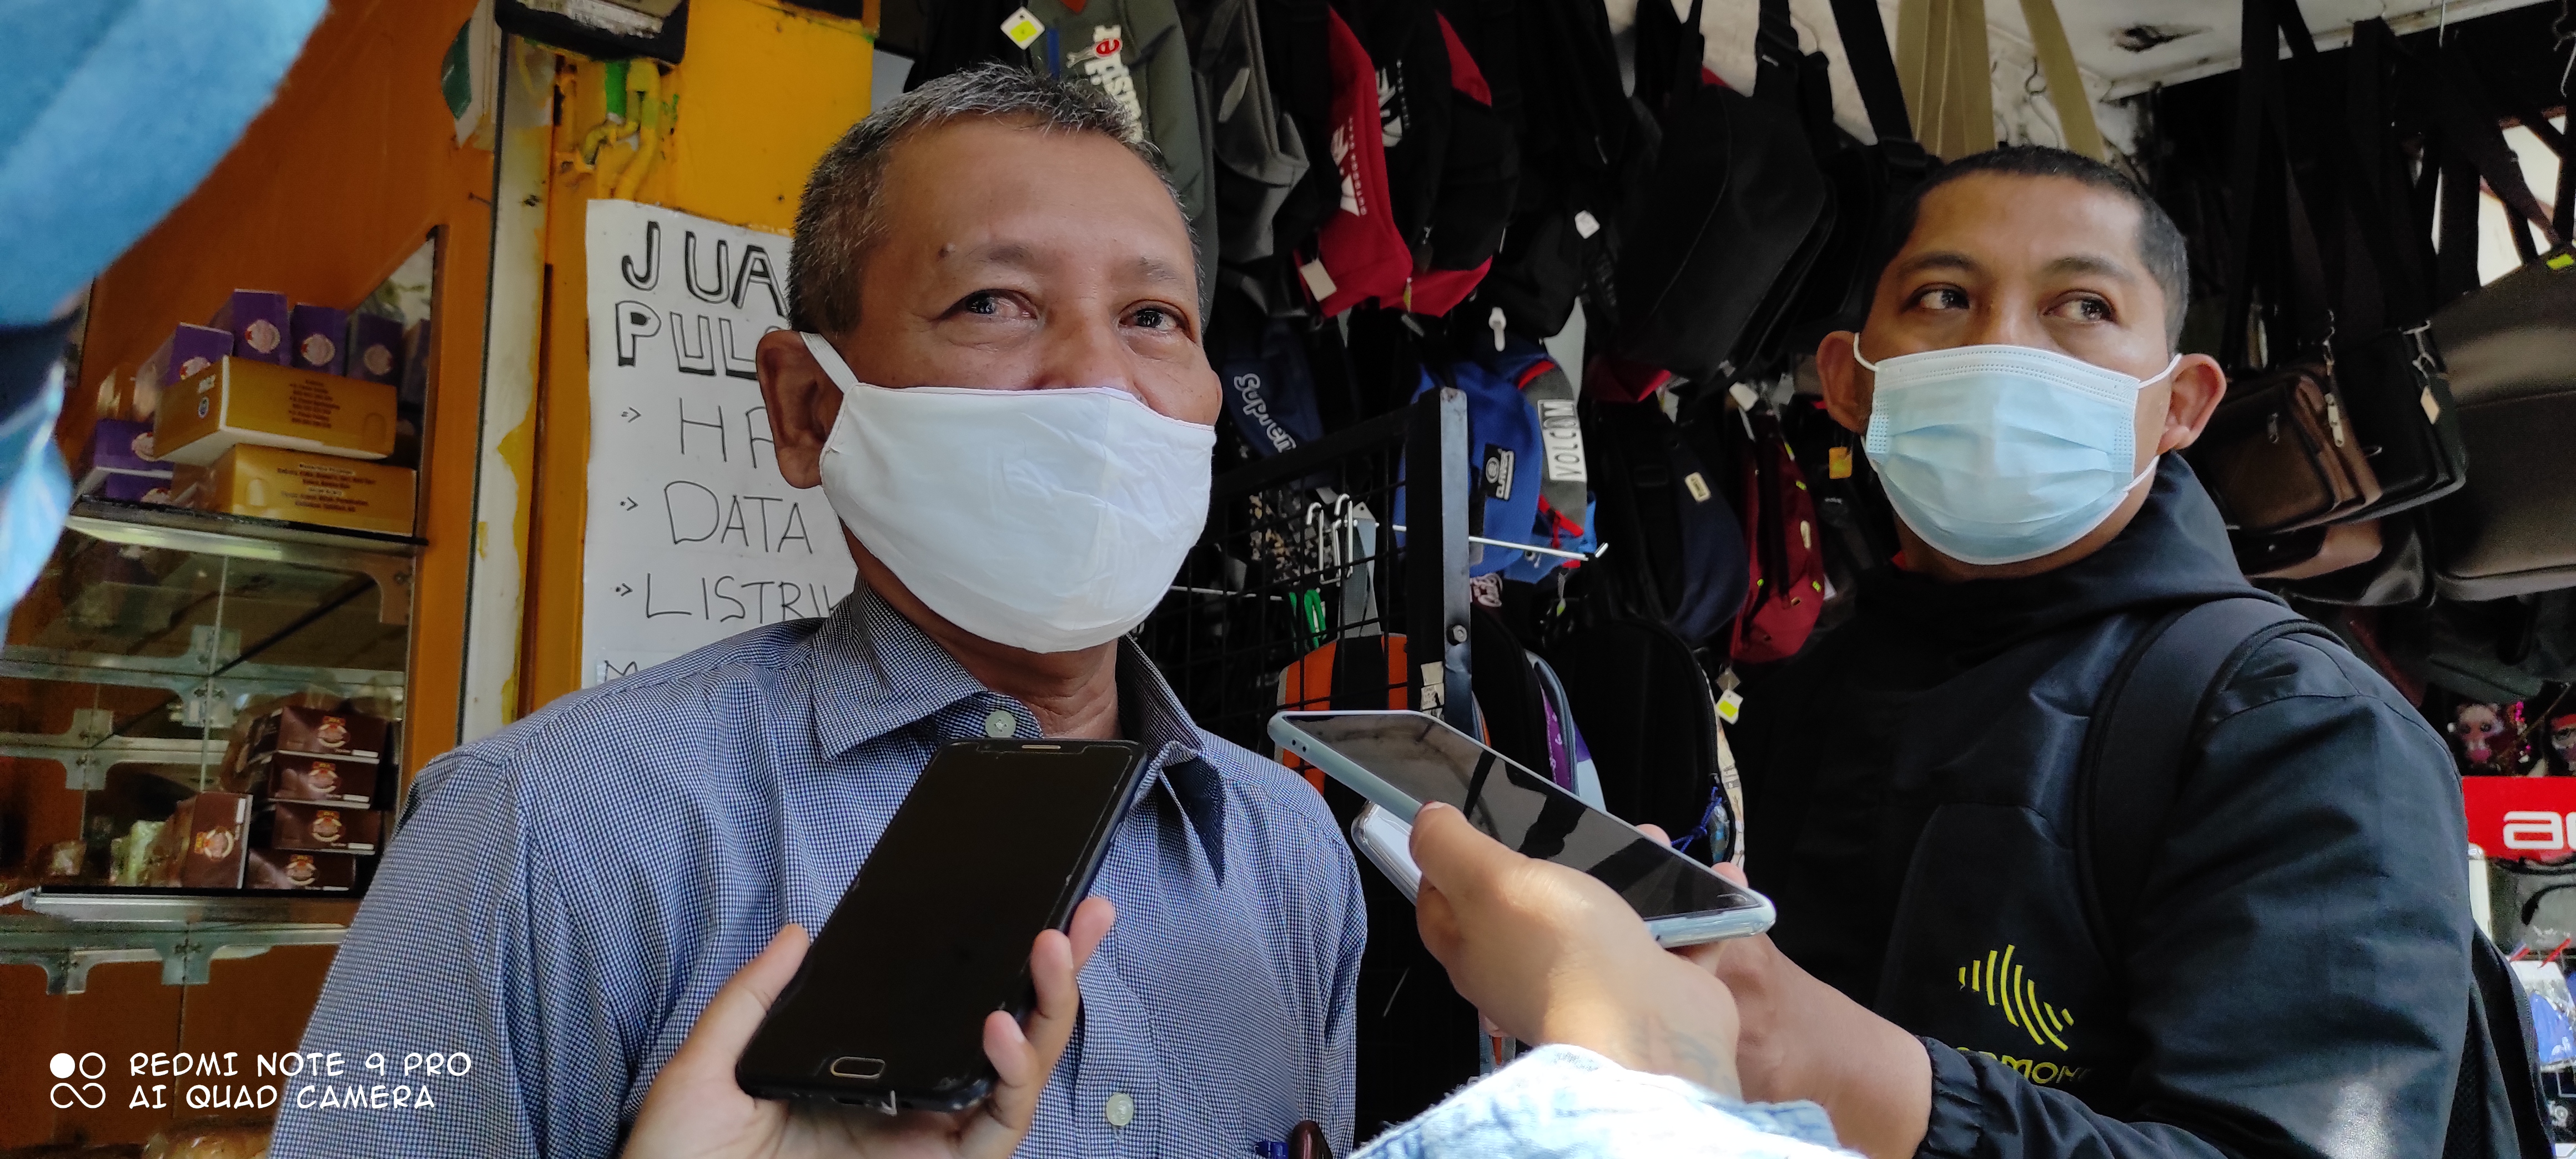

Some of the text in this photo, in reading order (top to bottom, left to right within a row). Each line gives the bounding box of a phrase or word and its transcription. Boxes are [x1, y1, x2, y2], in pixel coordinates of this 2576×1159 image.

[615, 300, 782, 380] PUL
[1542, 401, 1583, 478] VOLCOM
[663, 480, 814, 554] DATA
[2503, 810, 2576, 850] a
